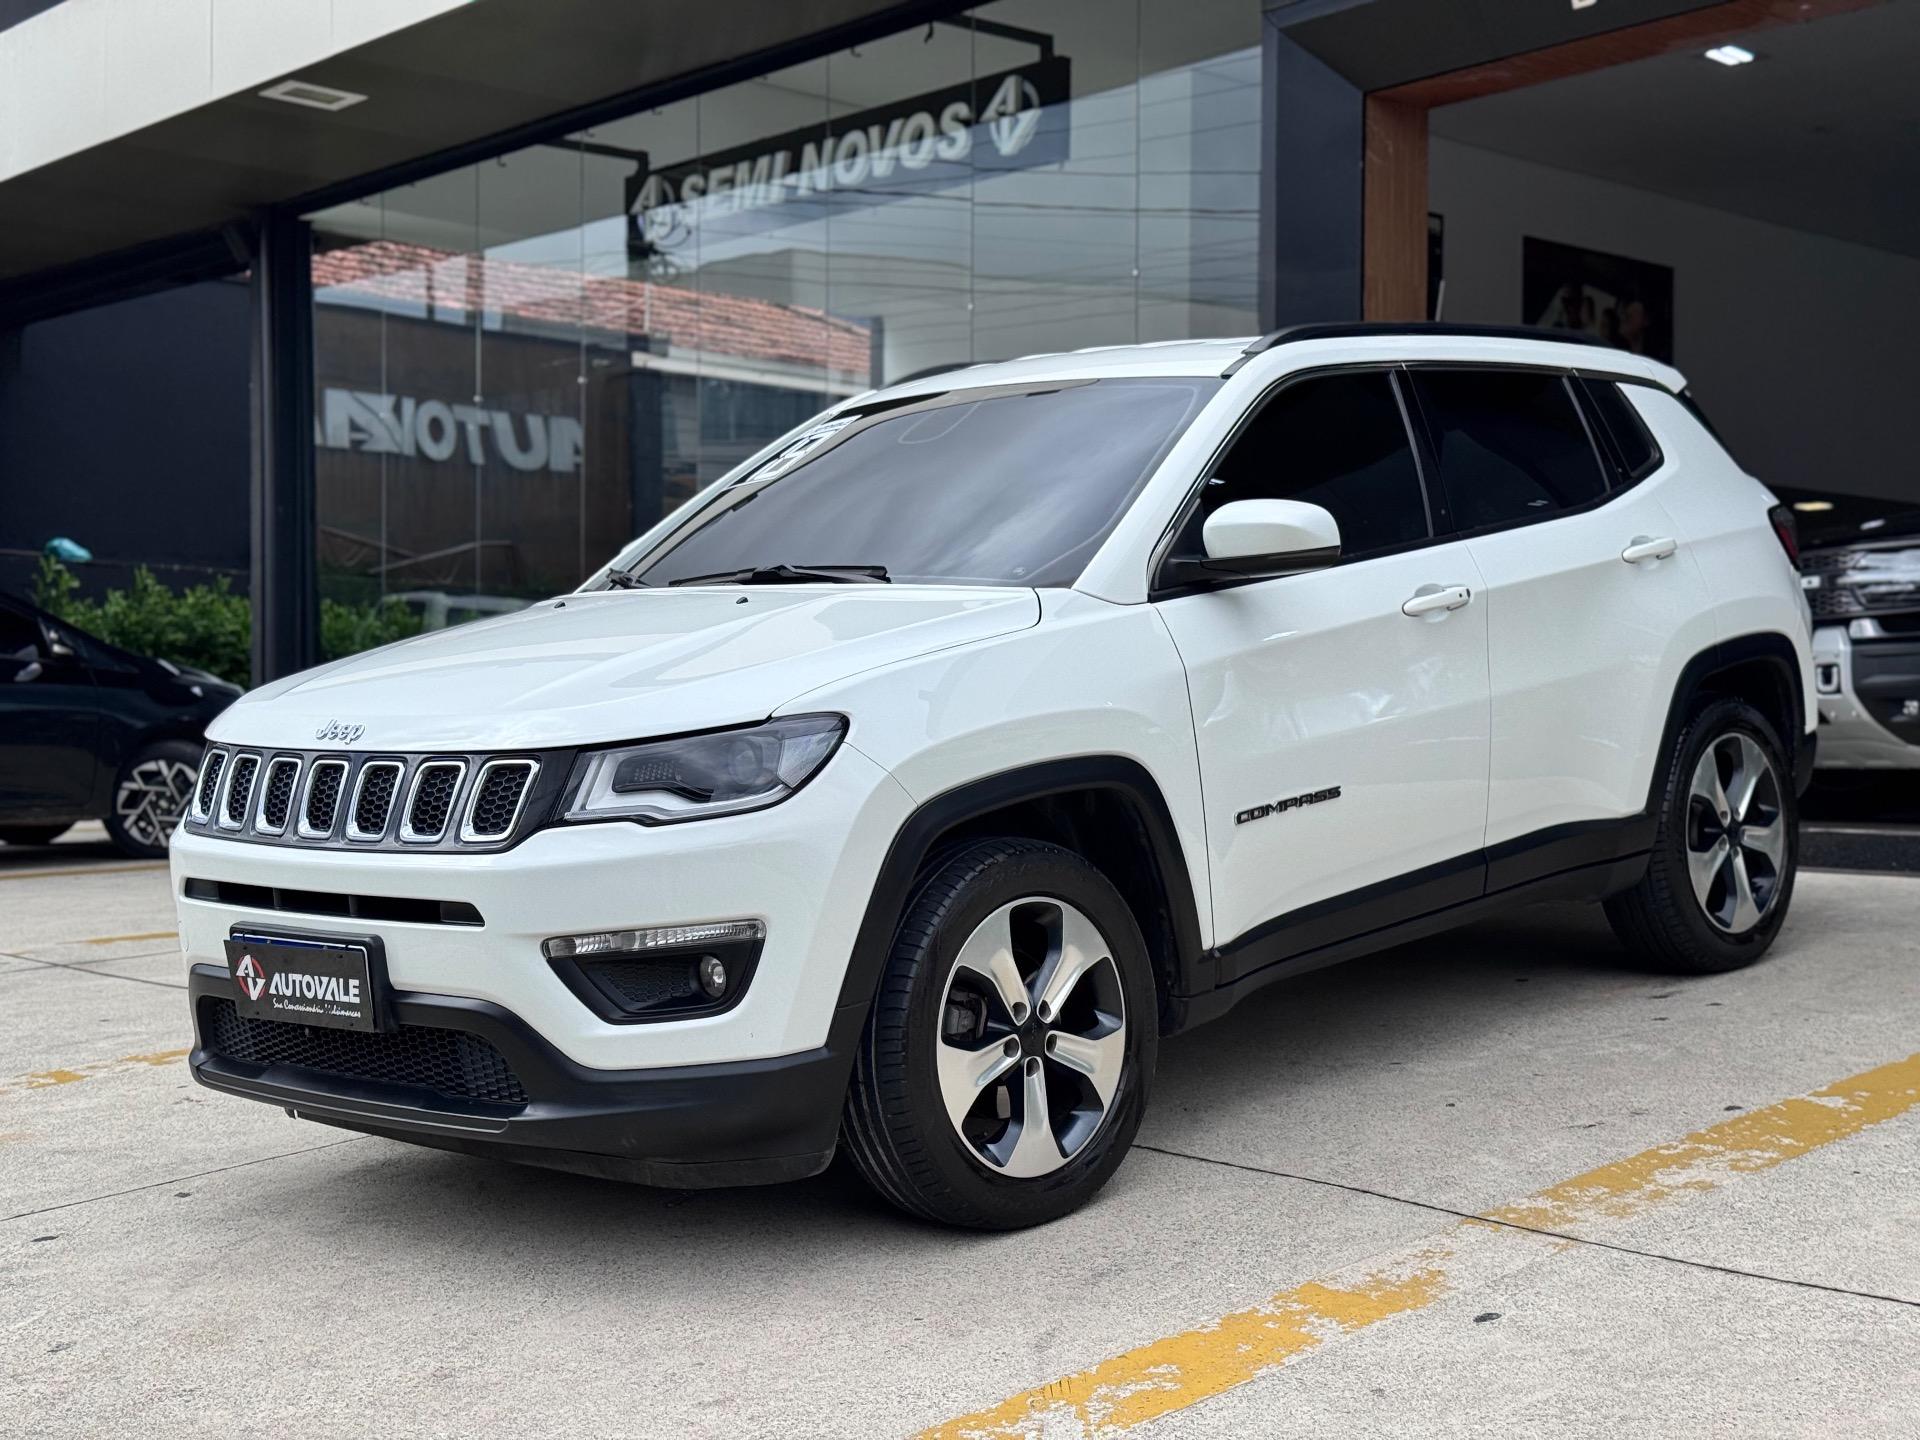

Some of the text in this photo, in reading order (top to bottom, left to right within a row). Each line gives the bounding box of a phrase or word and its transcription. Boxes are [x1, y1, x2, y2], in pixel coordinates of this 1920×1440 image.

[315, 719, 366, 746] Jeep
[1235, 785, 1342, 825] COMPASS
[268, 972, 361, 1004] AUTOVALE
